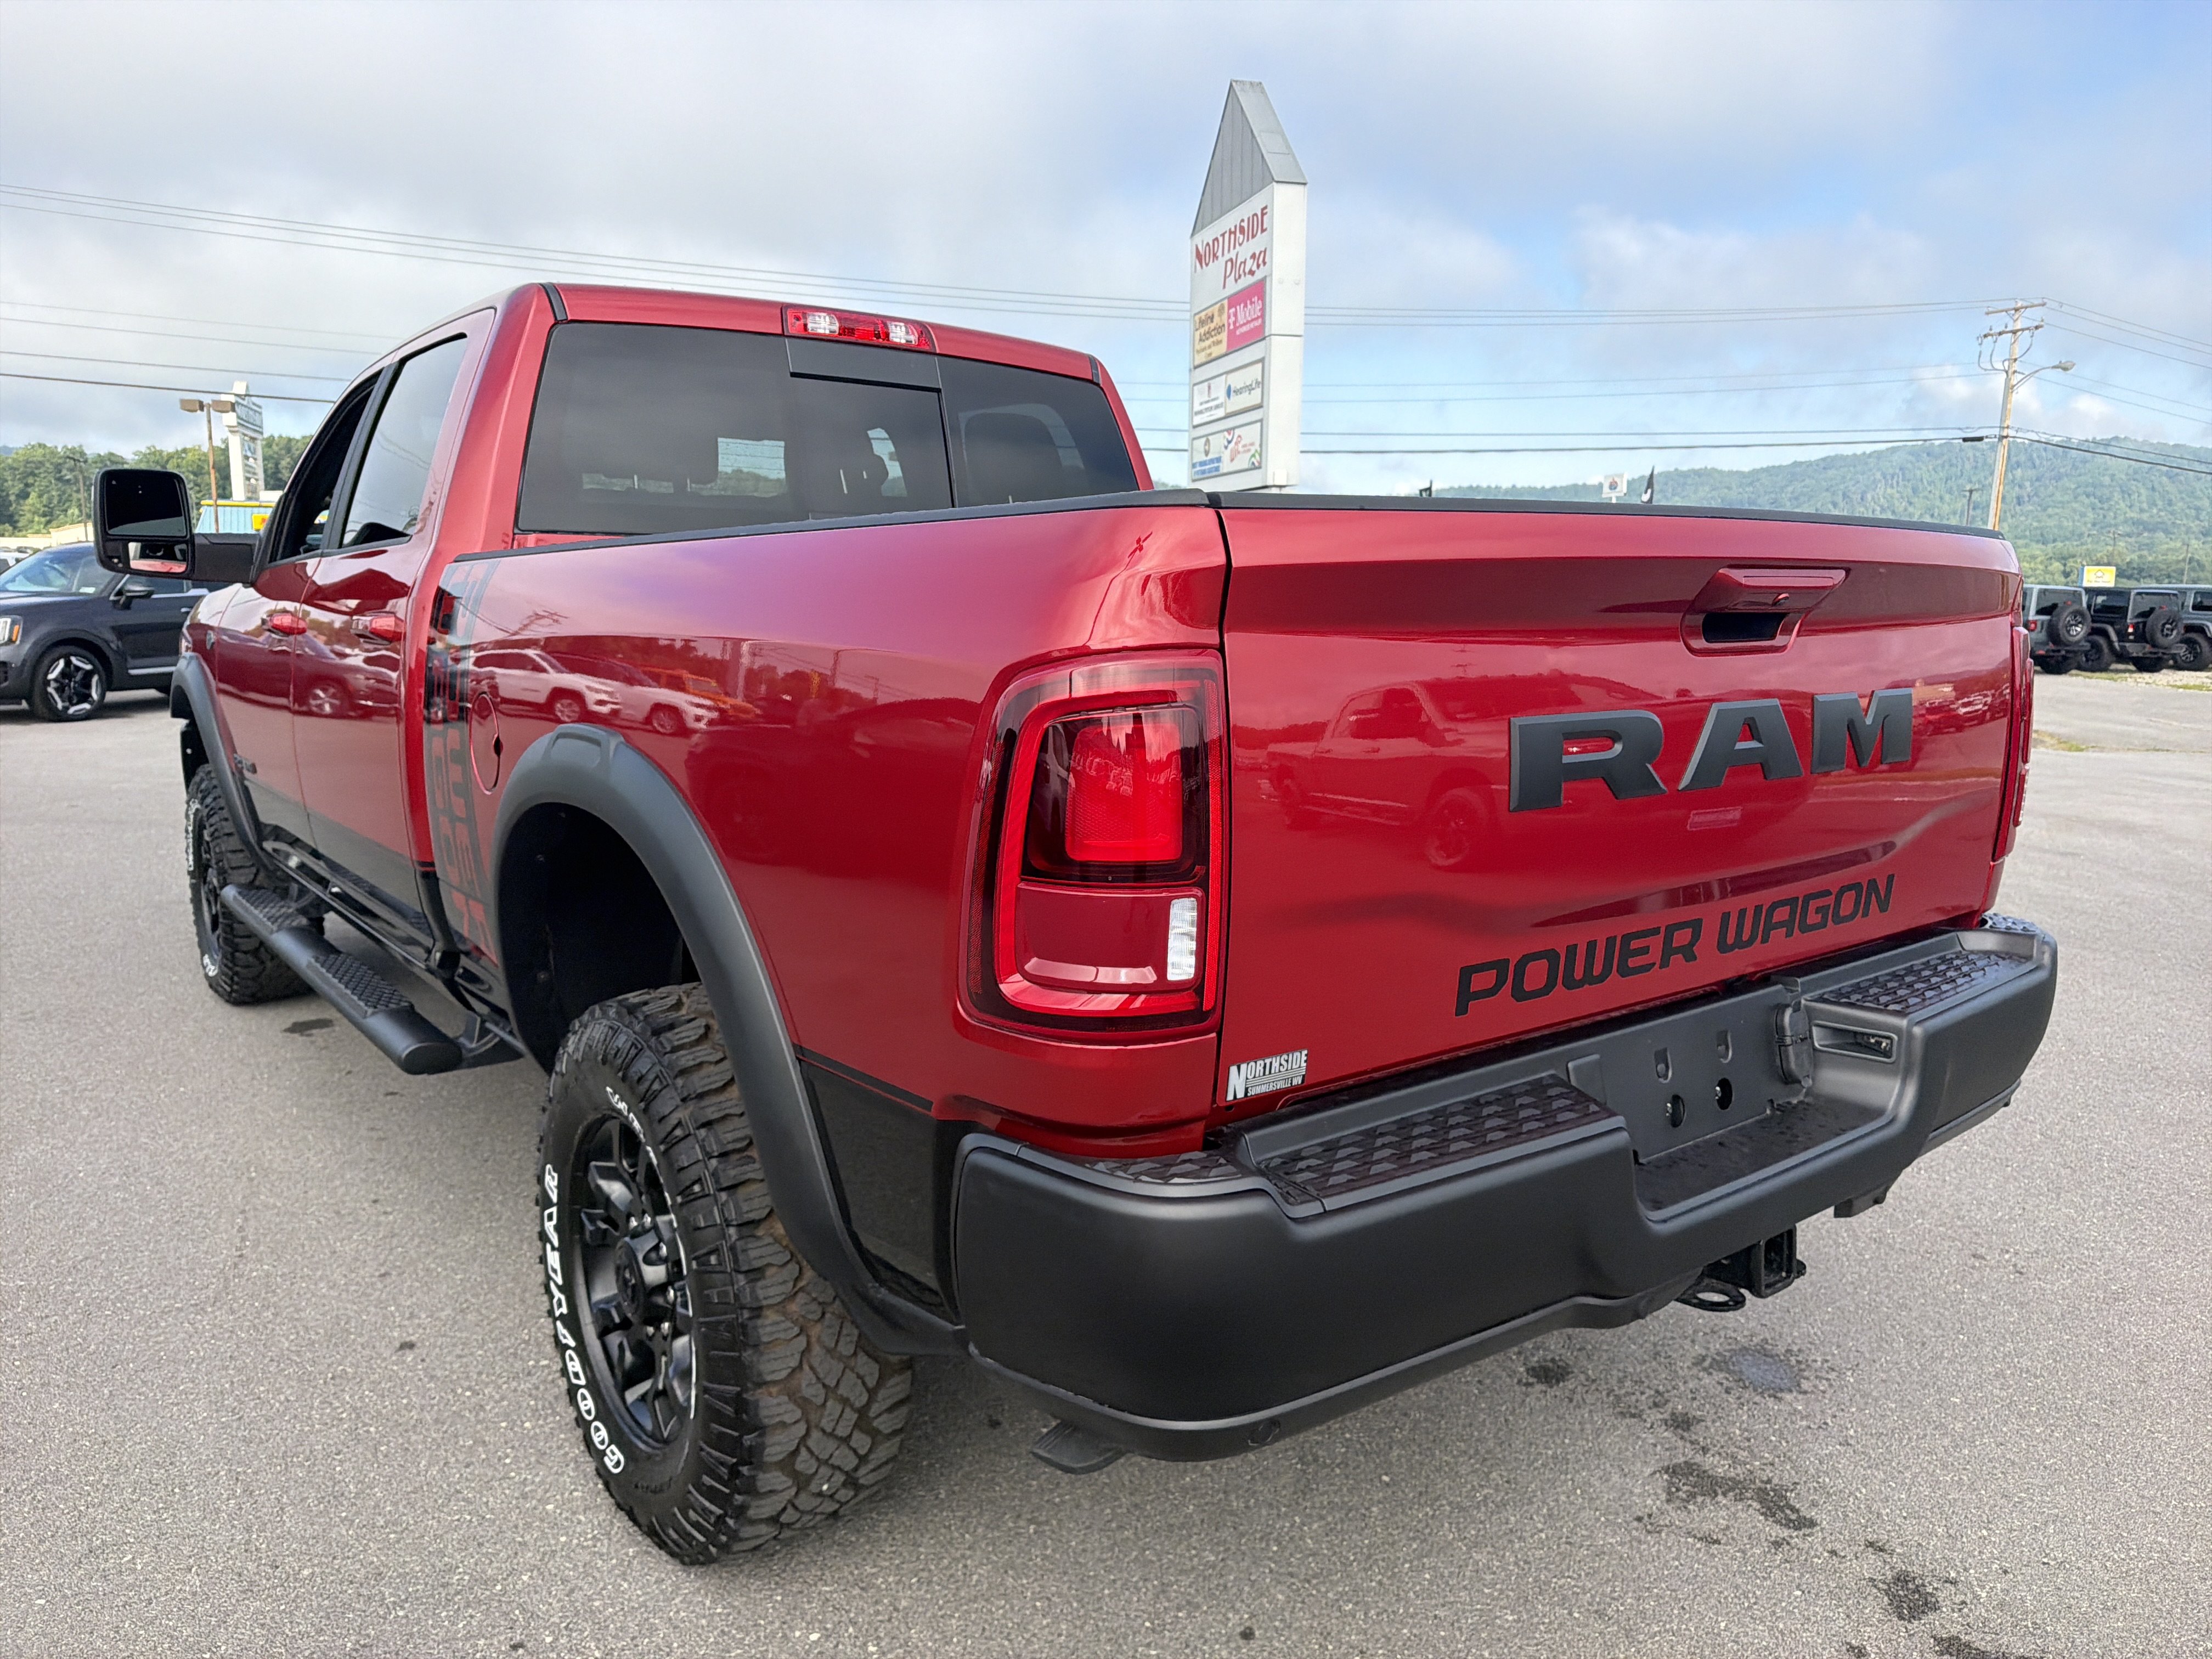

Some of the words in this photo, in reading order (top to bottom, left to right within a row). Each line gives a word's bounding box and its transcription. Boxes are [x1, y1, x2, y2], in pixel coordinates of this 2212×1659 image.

[1194, 205, 1268, 273] NORTHSIDE
[1223, 247, 1267, 289] Plaza
[1510, 687, 1912, 812] RAM
[1455, 918, 1702, 1016] POWER
[1717, 874, 1895, 955] WAGON
[1226, 1049, 1307, 1101] NORTHSIDE
[1248, 1077, 1291, 1096] SUMMERSVILLE
[1292, 1075, 1302, 1086] WV
[544, 1164, 624, 1474] GOODYEAR
